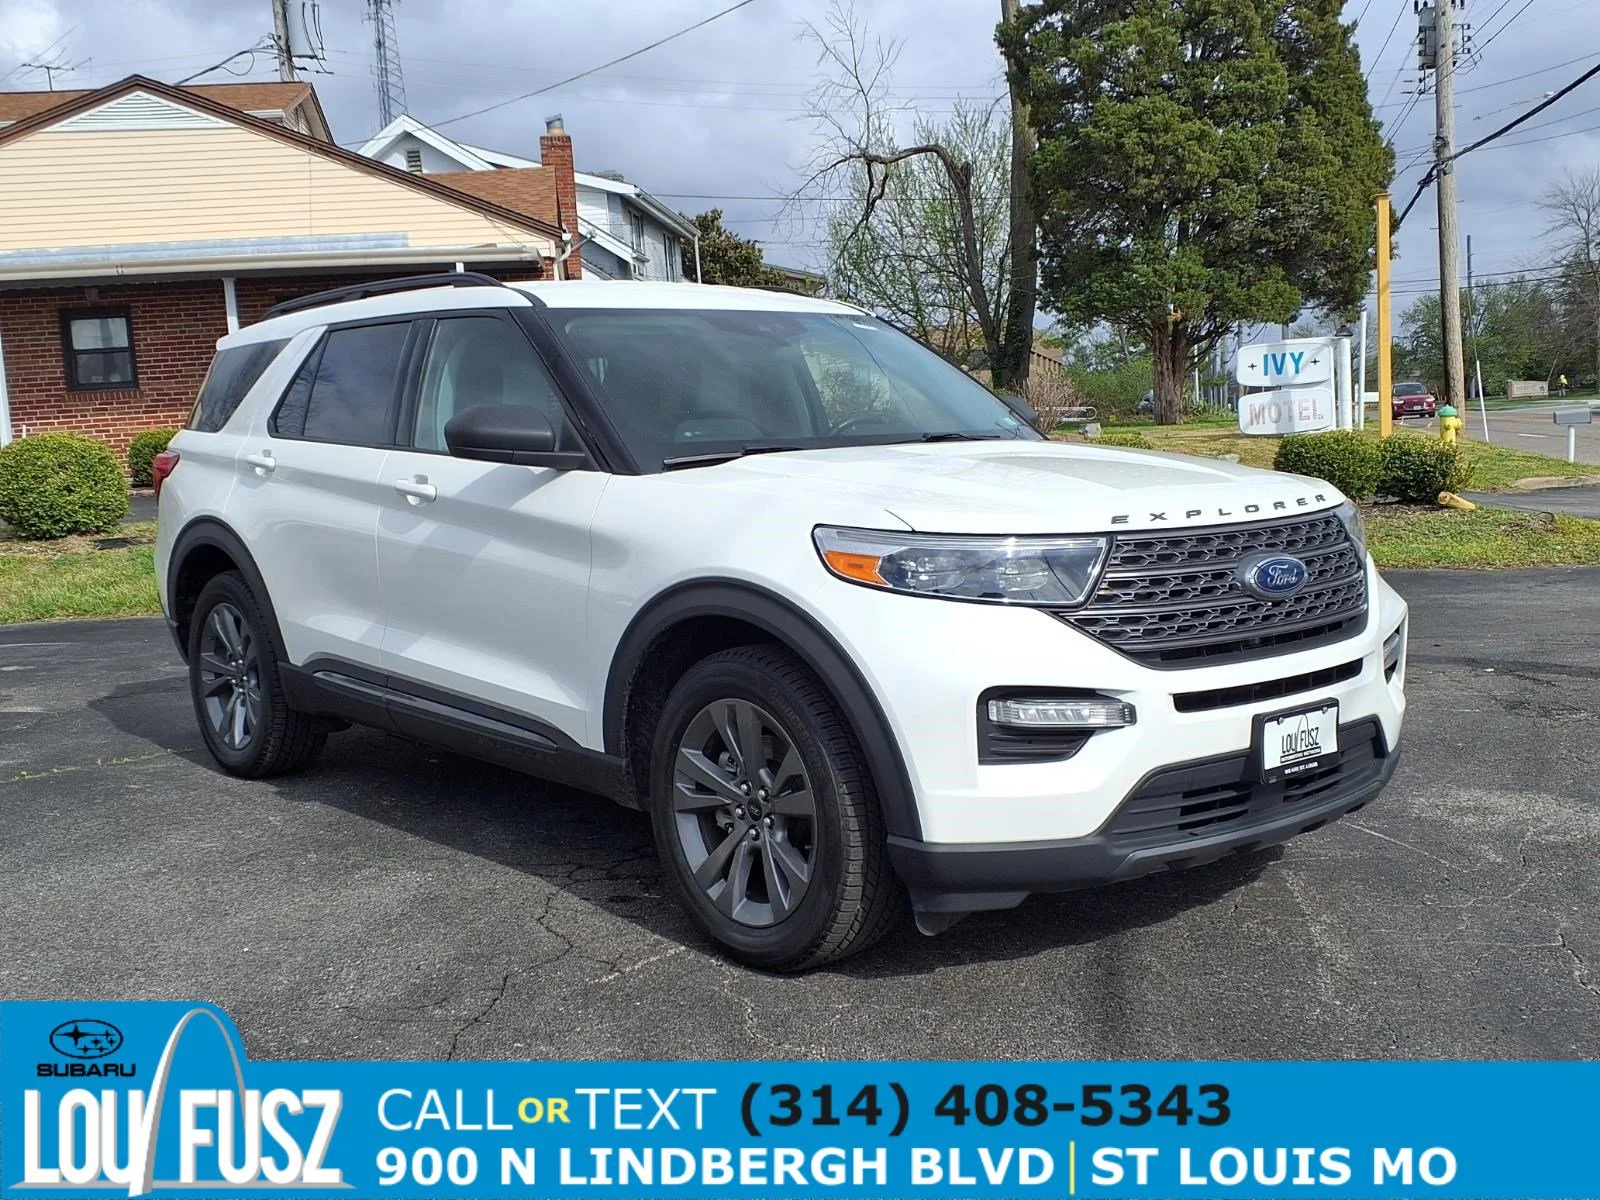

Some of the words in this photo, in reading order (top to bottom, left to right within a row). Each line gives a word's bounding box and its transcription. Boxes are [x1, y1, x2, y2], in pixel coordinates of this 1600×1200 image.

[1263, 351, 1305, 376] IVY
[1249, 398, 1324, 426] MOTEL
[1110, 493, 1326, 525] EXPLORER
[1267, 564, 1298, 587] Ford
[1281, 732, 1298, 754] LOU
[1300, 727, 1320, 750] FUSZ
